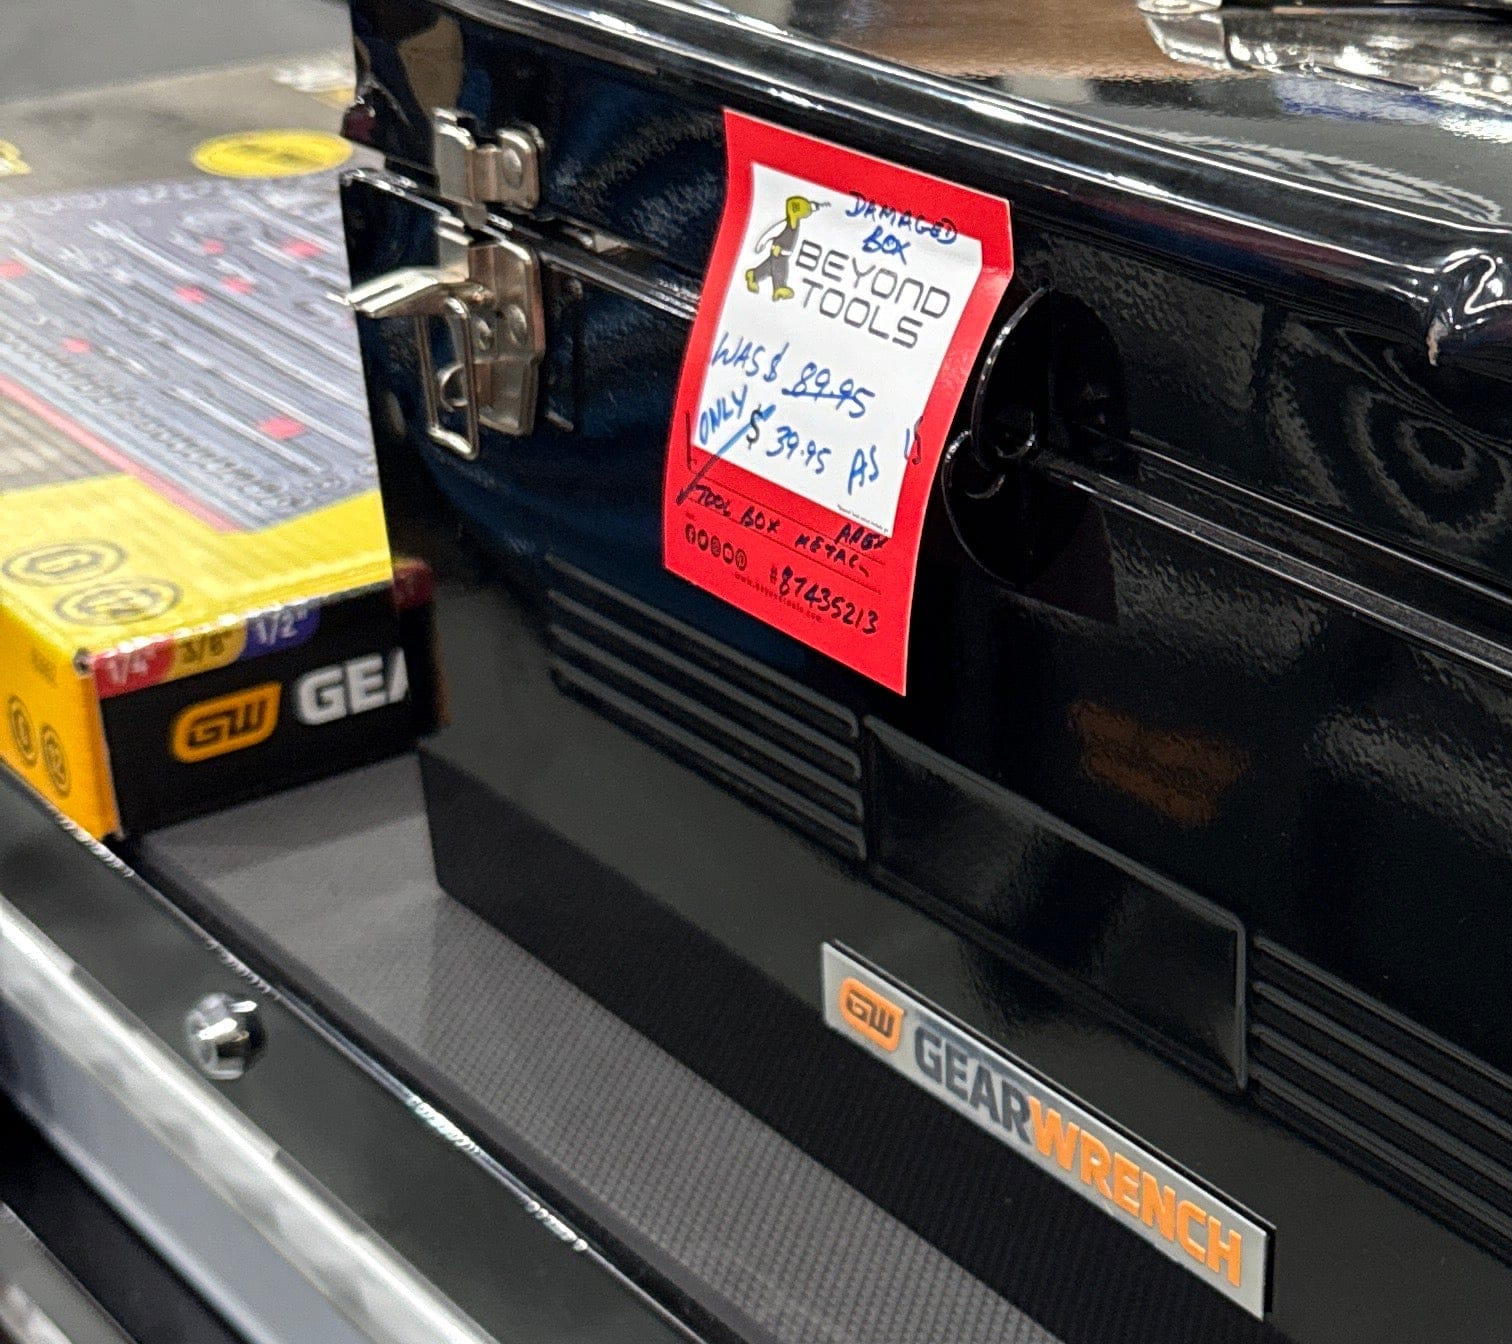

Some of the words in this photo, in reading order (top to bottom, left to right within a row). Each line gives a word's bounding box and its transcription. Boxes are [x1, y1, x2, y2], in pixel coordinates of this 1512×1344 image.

[846, 191, 957, 244] DAMAGED
[861, 226, 911, 265] BOX
[795, 239, 951, 319] BEYOND
[802, 278, 923, 349] TOOLS
[700, 384, 748, 445] ONLY
[845, 988, 896, 1040] GW
[914, 1025, 1242, 1288] GEARWRENCH
